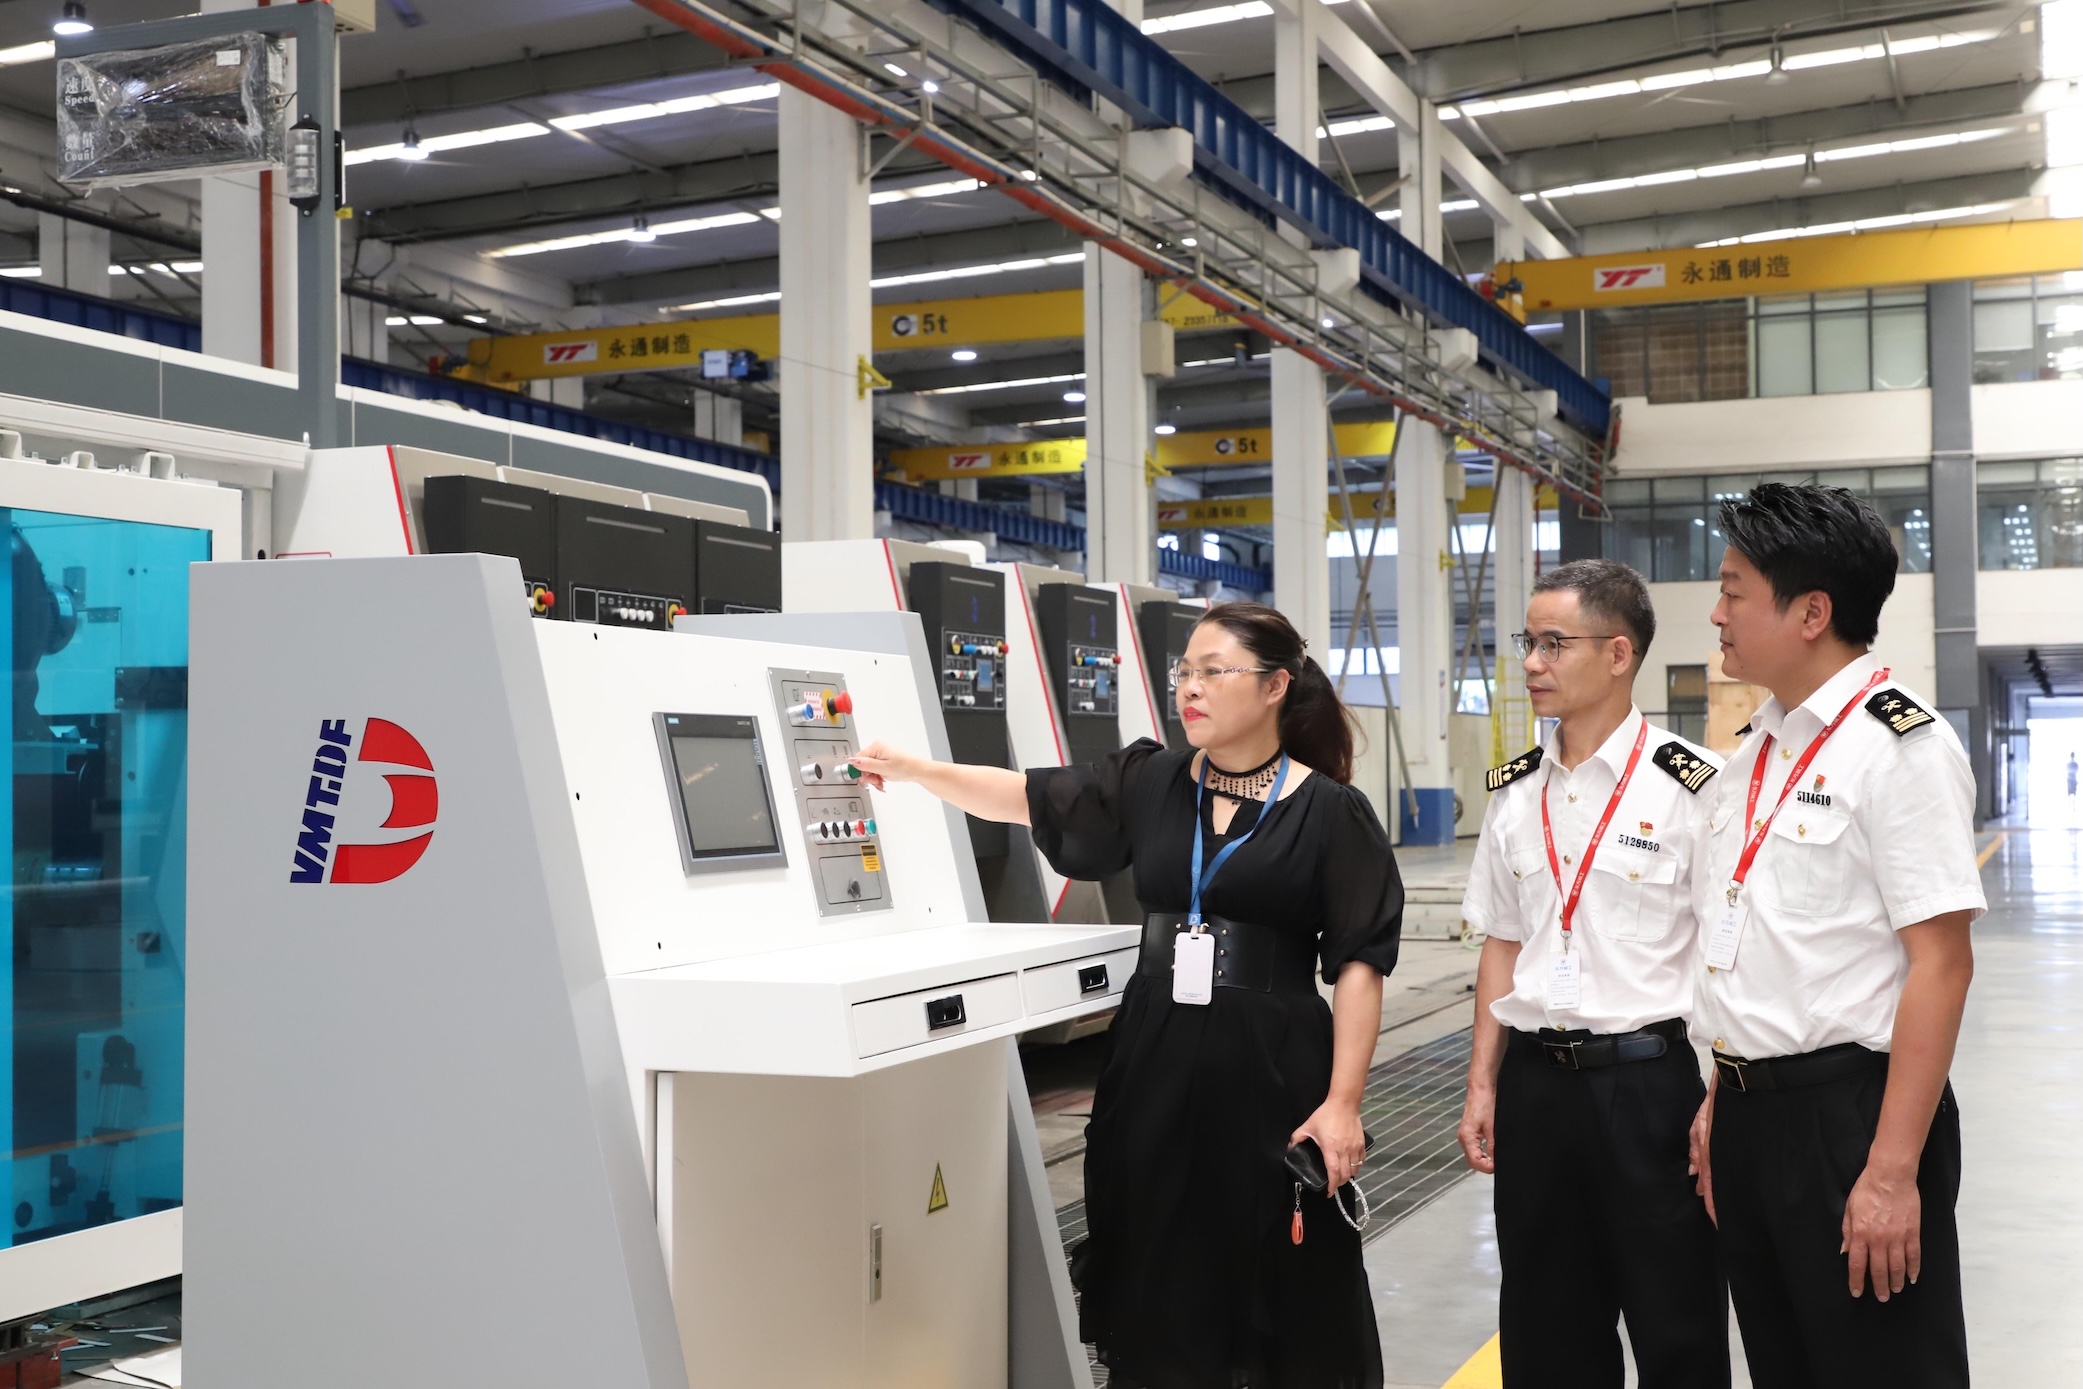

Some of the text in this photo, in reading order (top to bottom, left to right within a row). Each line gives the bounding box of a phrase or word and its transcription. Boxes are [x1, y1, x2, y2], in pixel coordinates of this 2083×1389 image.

[65, 96, 96, 106] Speed
[65, 151, 95, 162] Count
[1682, 254, 1790, 284] 永通制造
[923, 313, 948, 336] 5t
[609, 333, 691, 359] 永通制造
[1238, 437, 1258, 454] 5t
[1797, 790, 1831, 806] 5114610
[1618, 834, 1660, 852] 5128850
